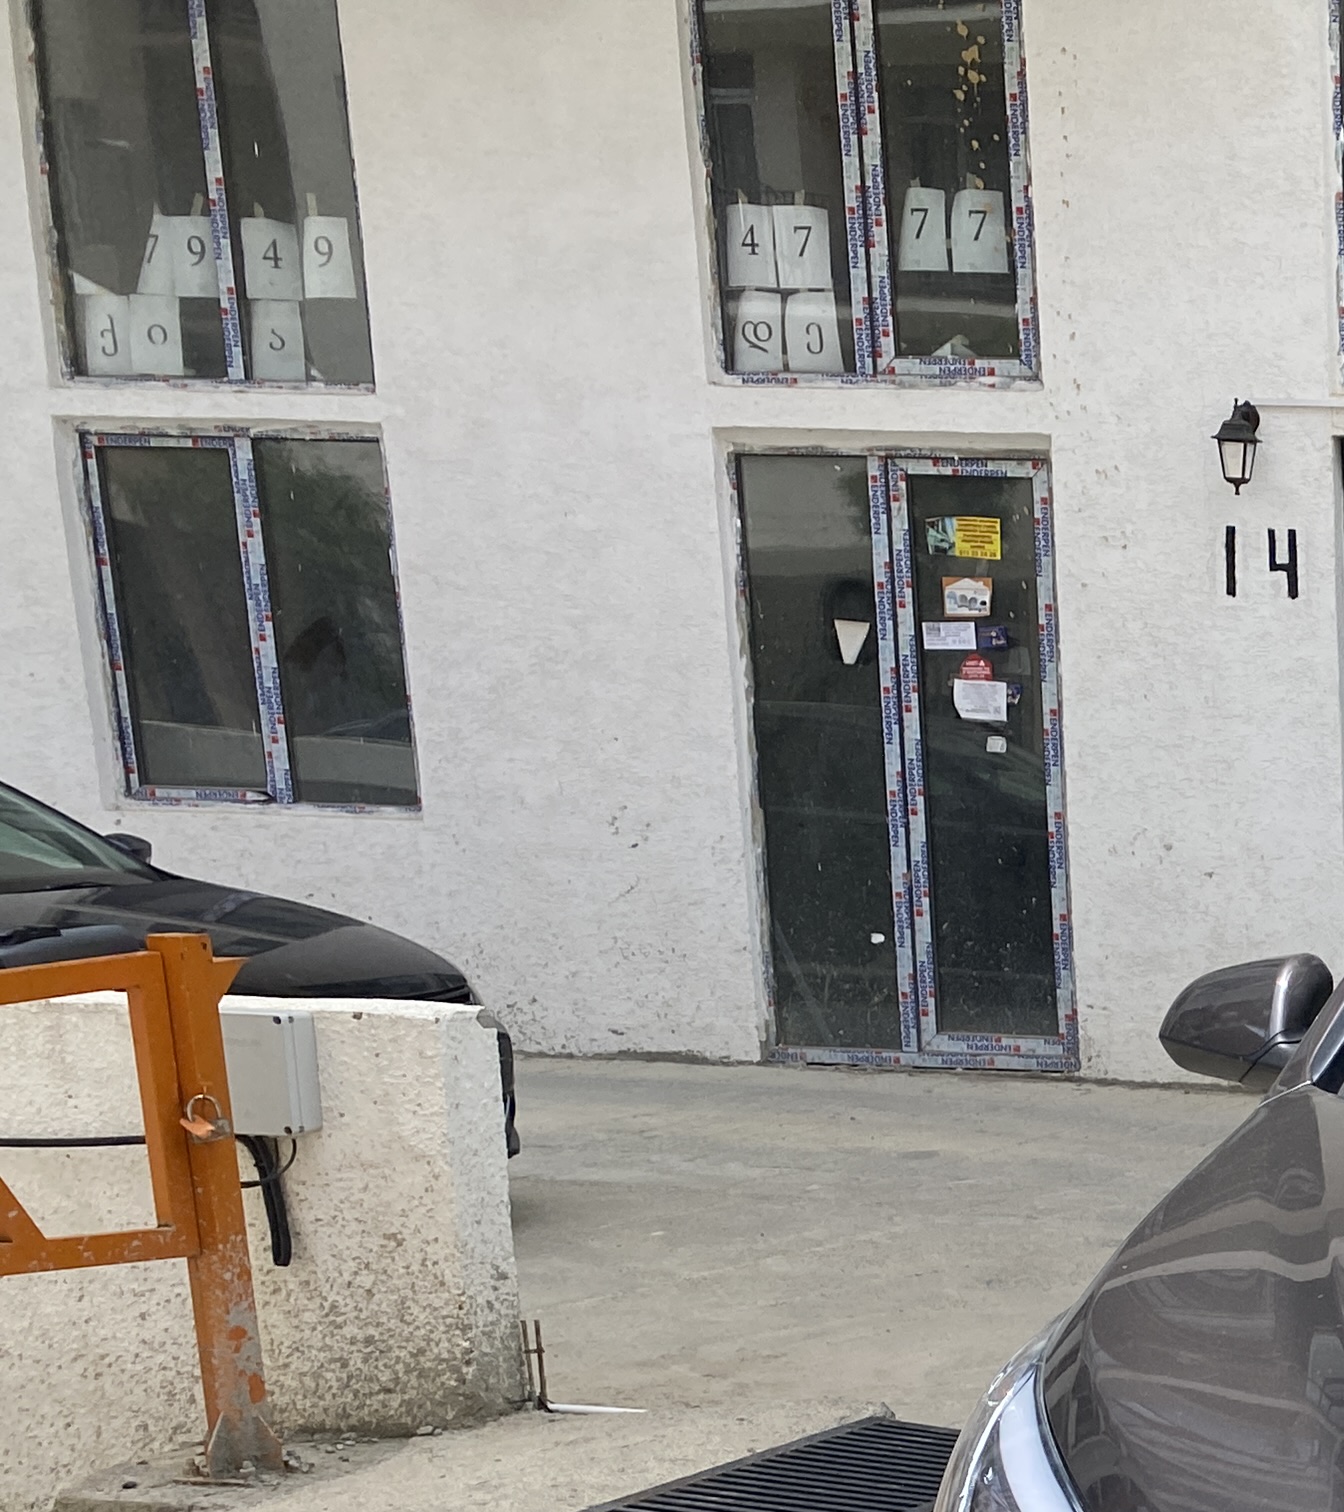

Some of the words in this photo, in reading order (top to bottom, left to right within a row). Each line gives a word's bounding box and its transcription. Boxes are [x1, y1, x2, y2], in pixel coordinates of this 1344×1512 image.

[864, 51, 875, 104] ENDERPEN
[841, 104, 851, 157] ENDERPEN
[1010, 104, 1021, 156] ENDERPEN
[215, 187, 229, 239] ENDERPEN
[872, 164, 884, 217] ENDERPEN
[186, 235, 206, 266] 9
[262, 238, 283, 269] 4
[314, 236, 334, 267] 9
[741, 224, 760, 255] 4
[793, 226, 812, 256] 7
[910, 208, 929, 240] 7
[968, 210, 988, 241] 7
[848, 217, 859, 269] ENDERPEN
[1016, 217, 1027, 269] ENDERPEN
[228, 297, 239, 347] ENDERPEN
[879, 276, 890, 327] ENDERPEN
[938, 367, 986, 376] ENDERPEN
[107, 435, 151, 446] ENDERPEN
[941, 459, 988, 468] ENDERPEN
[241, 479, 253, 528] ENDERPEN
[871, 484, 881, 535] ENDERPEN
[1040, 507, 1050, 557] ENDERPEN
[896, 549, 906, 598] ENDERPEN
[1225, 525, 1299, 599] 14
[253, 584, 265, 632] ENDERPEN
[877, 591, 887, 641] ENDERPEN
[1045, 614, 1055, 663] ENDERPEN
[902, 654, 912, 703] ENDERPEN
[265, 686, 278, 734] ENDERPEN
[883, 696, 893, 745] ENDERPEN
[1050, 718, 1059, 767] ENDERPEN
[907, 758, 917, 807] ENDERPEN
[889, 800, 899, 847] ENDERPEN
[1054, 822, 1064, 869] ENDERPEN
[913, 860, 923, 907] ENDERPEN
[895, 901, 905, 948] ENDERPEN
[1059, 923, 1069, 970] ENDERPEN
[919, 961, 928, 1007] ENDERPEN
[901, 1002, 911, 1047] ENDERPEN
[847, 1054, 892, 1064] ENDERPEN
[941, 1057, 986, 1066] ENDERPEN
